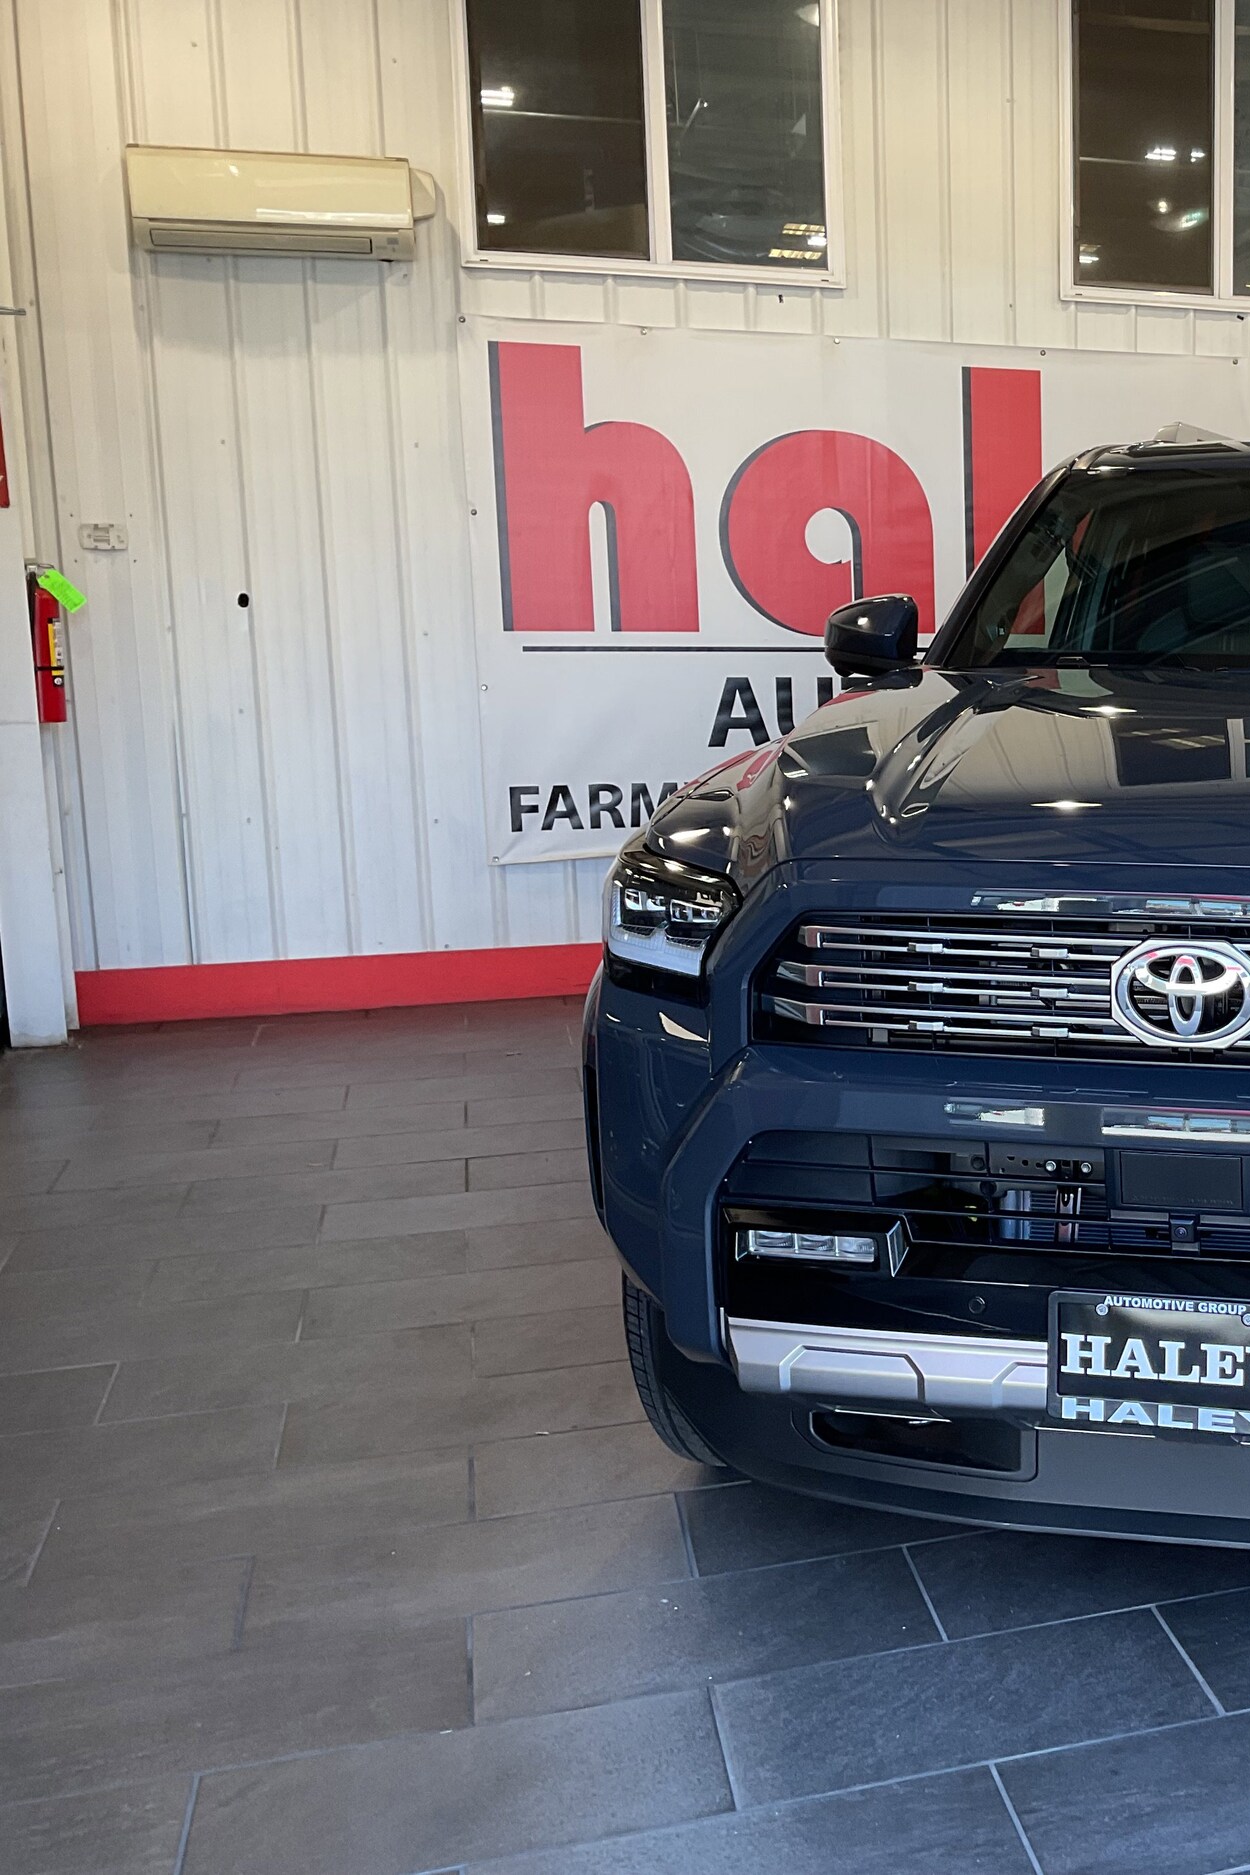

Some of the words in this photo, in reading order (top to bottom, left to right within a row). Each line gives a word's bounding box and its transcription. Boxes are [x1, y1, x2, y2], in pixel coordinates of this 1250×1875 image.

[488, 340, 1045, 637] hal
[509, 782, 689, 833] FARM
[1103, 1295, 1194, 1312] AUTOMOTIVE
[1198, 1301, 1246, 1315] GROUP
